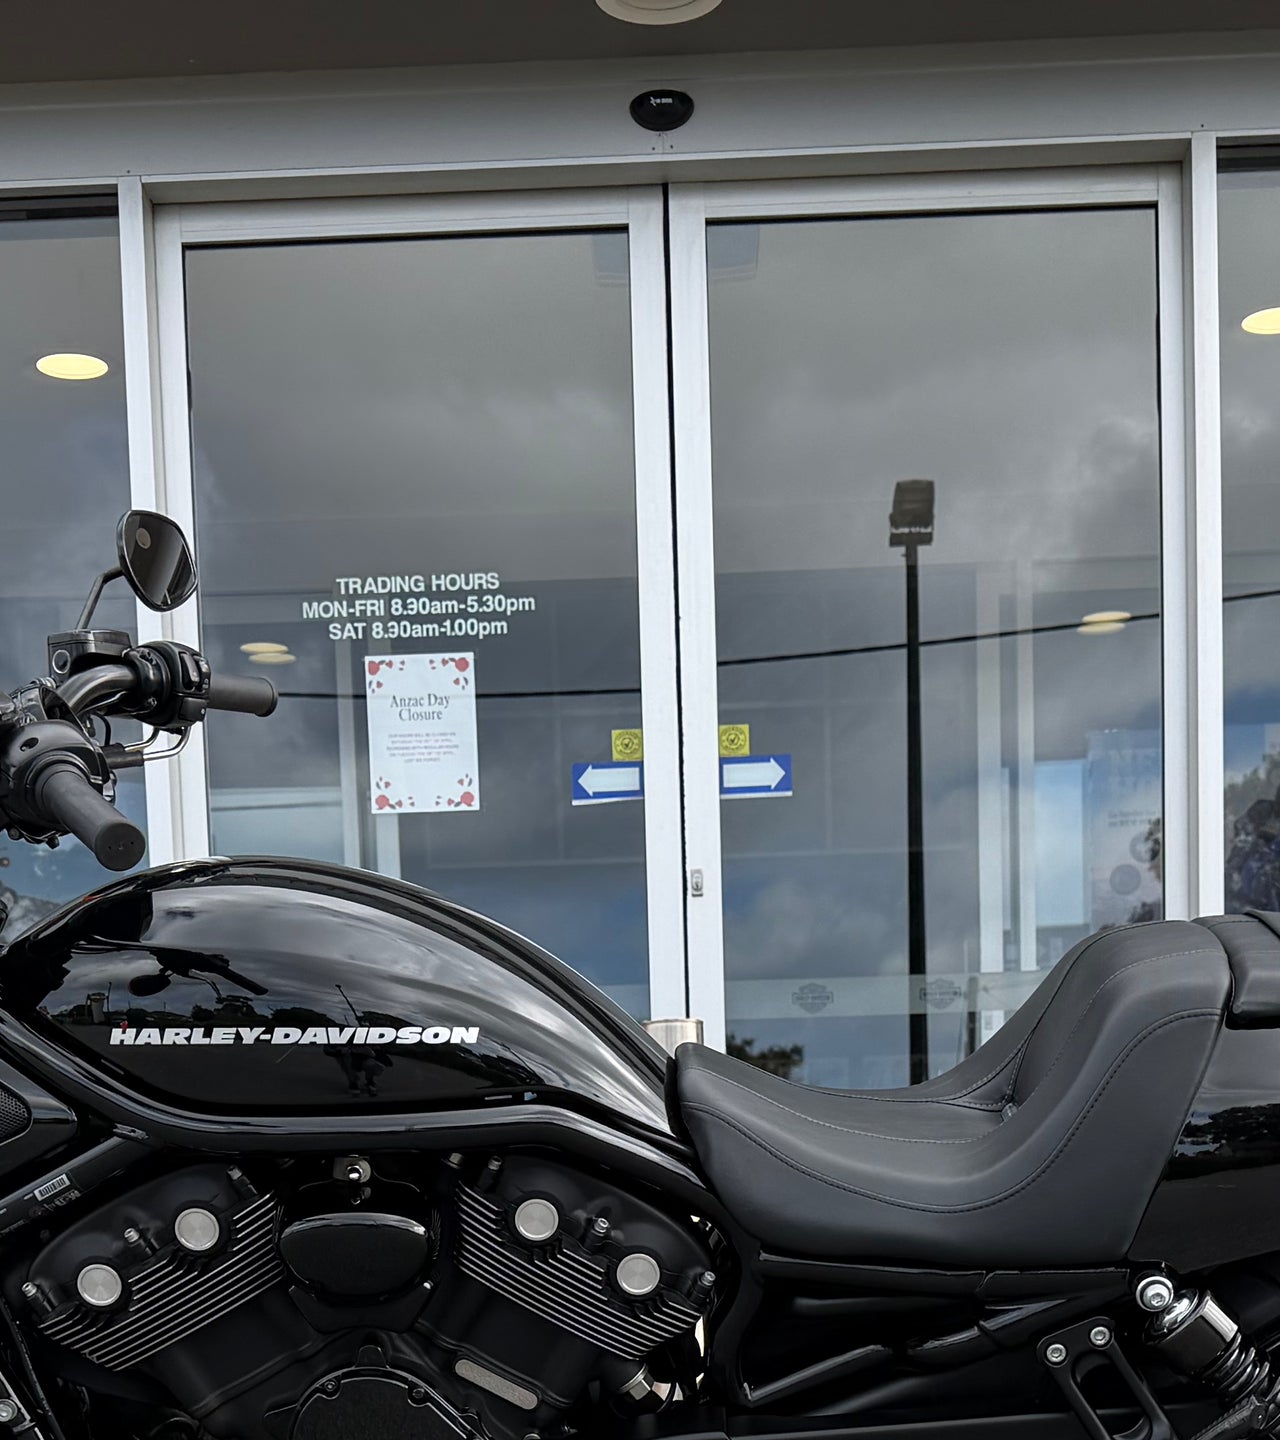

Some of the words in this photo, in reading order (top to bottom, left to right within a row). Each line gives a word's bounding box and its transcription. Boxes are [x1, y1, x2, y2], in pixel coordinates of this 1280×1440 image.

[336, 575, 425, 595] TRADING
[431, 572, 499, 592] HOURS
[302, 599, 385, 619] MON-FRI
[328, 622, 367, 640] SAT
[389, 694, 424, 708] Anzac
[427, 692, 451, 708] Day
[398, 708, 443, 722] Closure
[108, 1026, 480, 1046] HARLEY-DAVIDSON
